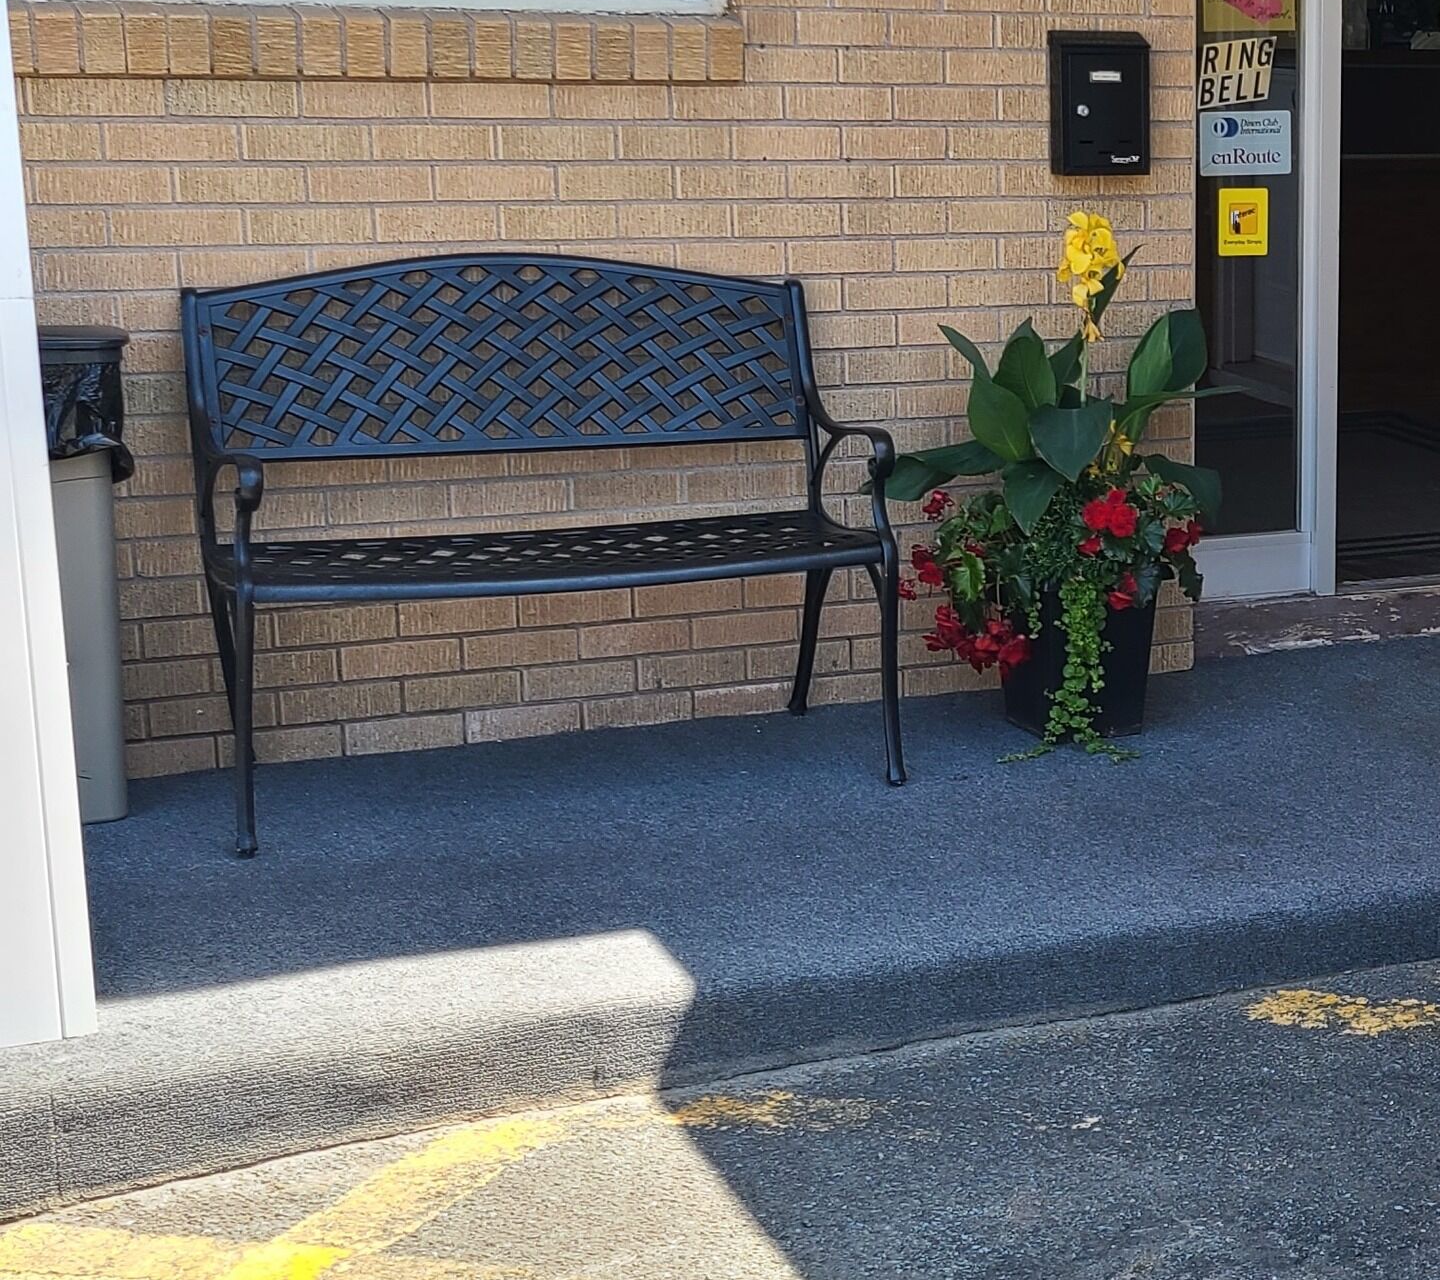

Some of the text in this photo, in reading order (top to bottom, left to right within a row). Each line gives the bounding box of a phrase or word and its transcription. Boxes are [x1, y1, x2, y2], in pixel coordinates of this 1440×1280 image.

[1203, 38, 1274, 75] RING
[1199, 71, 1265, 107] BELL
[1211, 147, 1281, 165] enRoute
